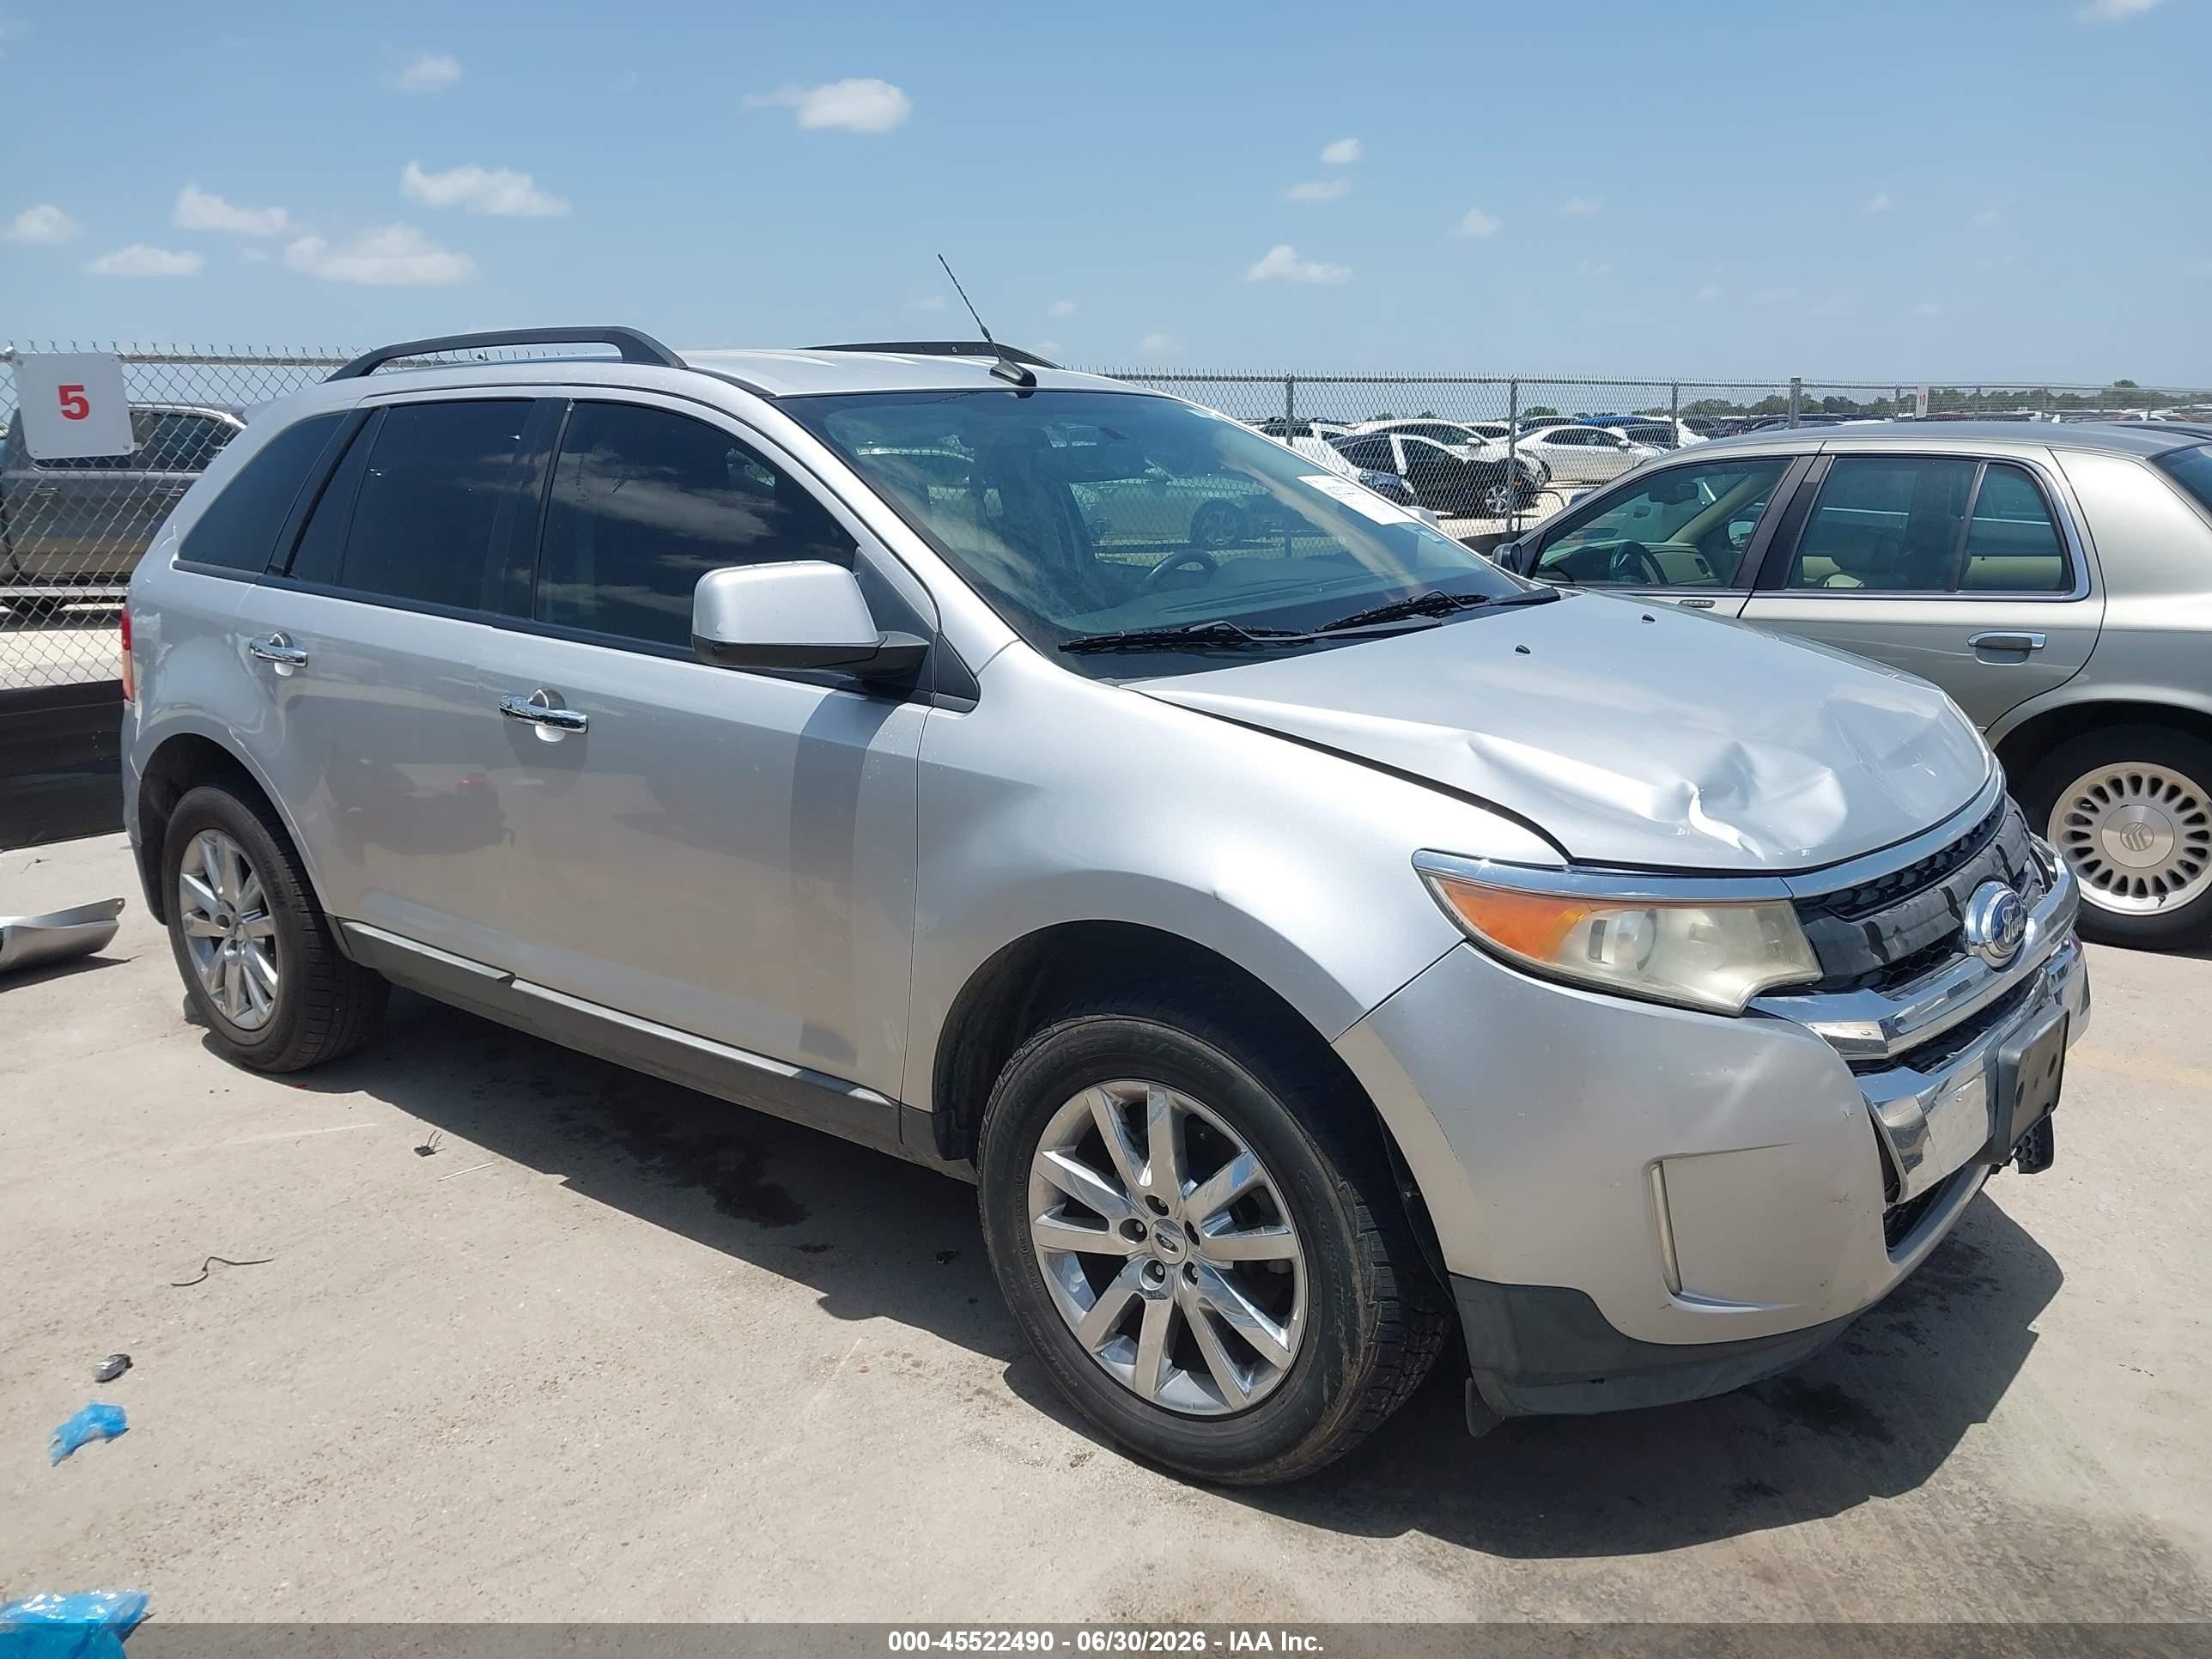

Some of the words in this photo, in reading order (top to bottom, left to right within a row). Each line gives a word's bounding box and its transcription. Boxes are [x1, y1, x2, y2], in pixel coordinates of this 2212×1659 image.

[58, 385, 89, 420] 5
[1919, 394, 1926, 405] 10
[2002, 902, 2027, 944] Ford
